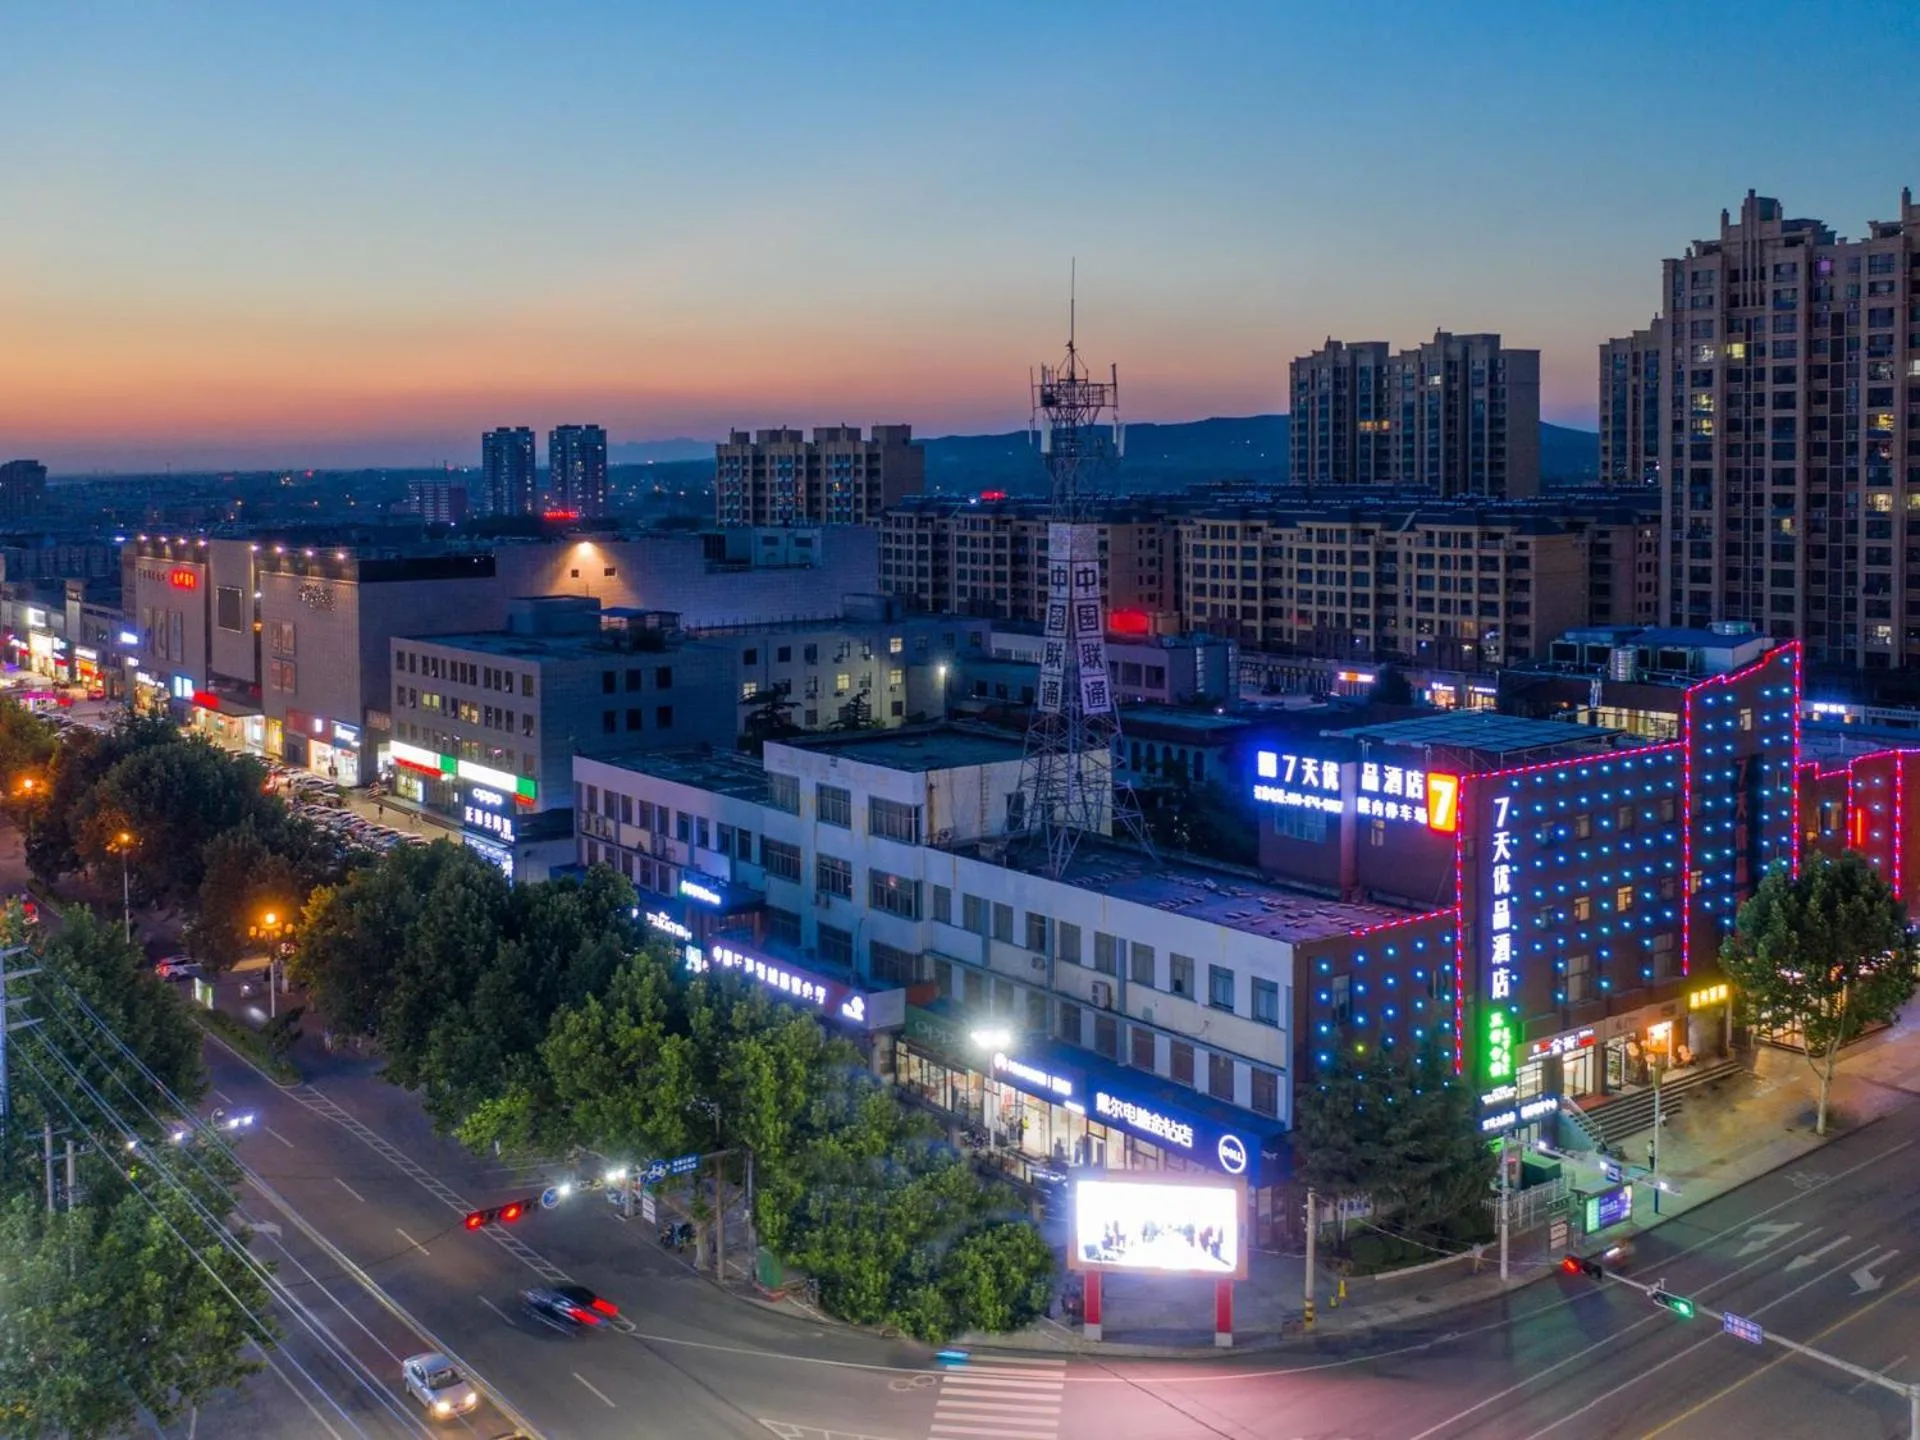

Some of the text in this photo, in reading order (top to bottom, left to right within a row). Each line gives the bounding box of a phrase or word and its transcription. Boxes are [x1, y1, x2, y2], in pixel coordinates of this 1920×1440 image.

[1042, 565, 1068, 709] 中国联通
[1075, 566, 1107, 710] 中国联通
[1281, 753, 1425, 800] 7天优品酒店
[1430, 779, 1456, 826] 7
[1491, 796, 1512, 1000] 7天优品酒店
